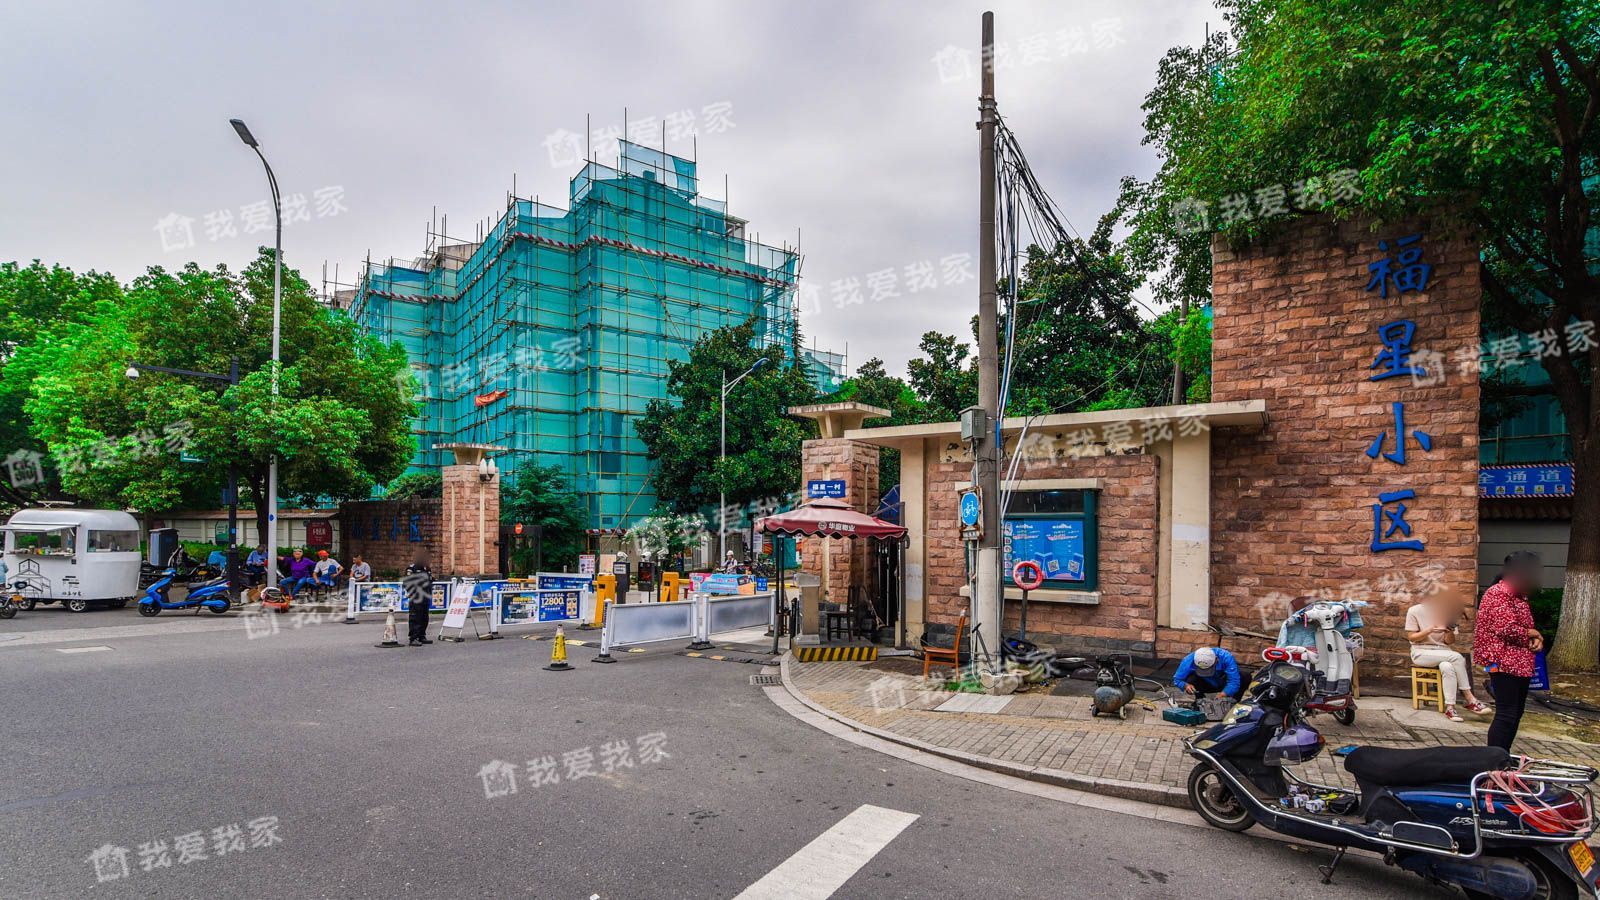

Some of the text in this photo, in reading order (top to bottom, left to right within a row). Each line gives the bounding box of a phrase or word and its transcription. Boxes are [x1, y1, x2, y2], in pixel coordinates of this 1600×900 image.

[1366, 232, 1432, 552] 福星小区
[1480, 469, 1562, 484] 全通道
[812, 483, 841, 491] 福星一村
